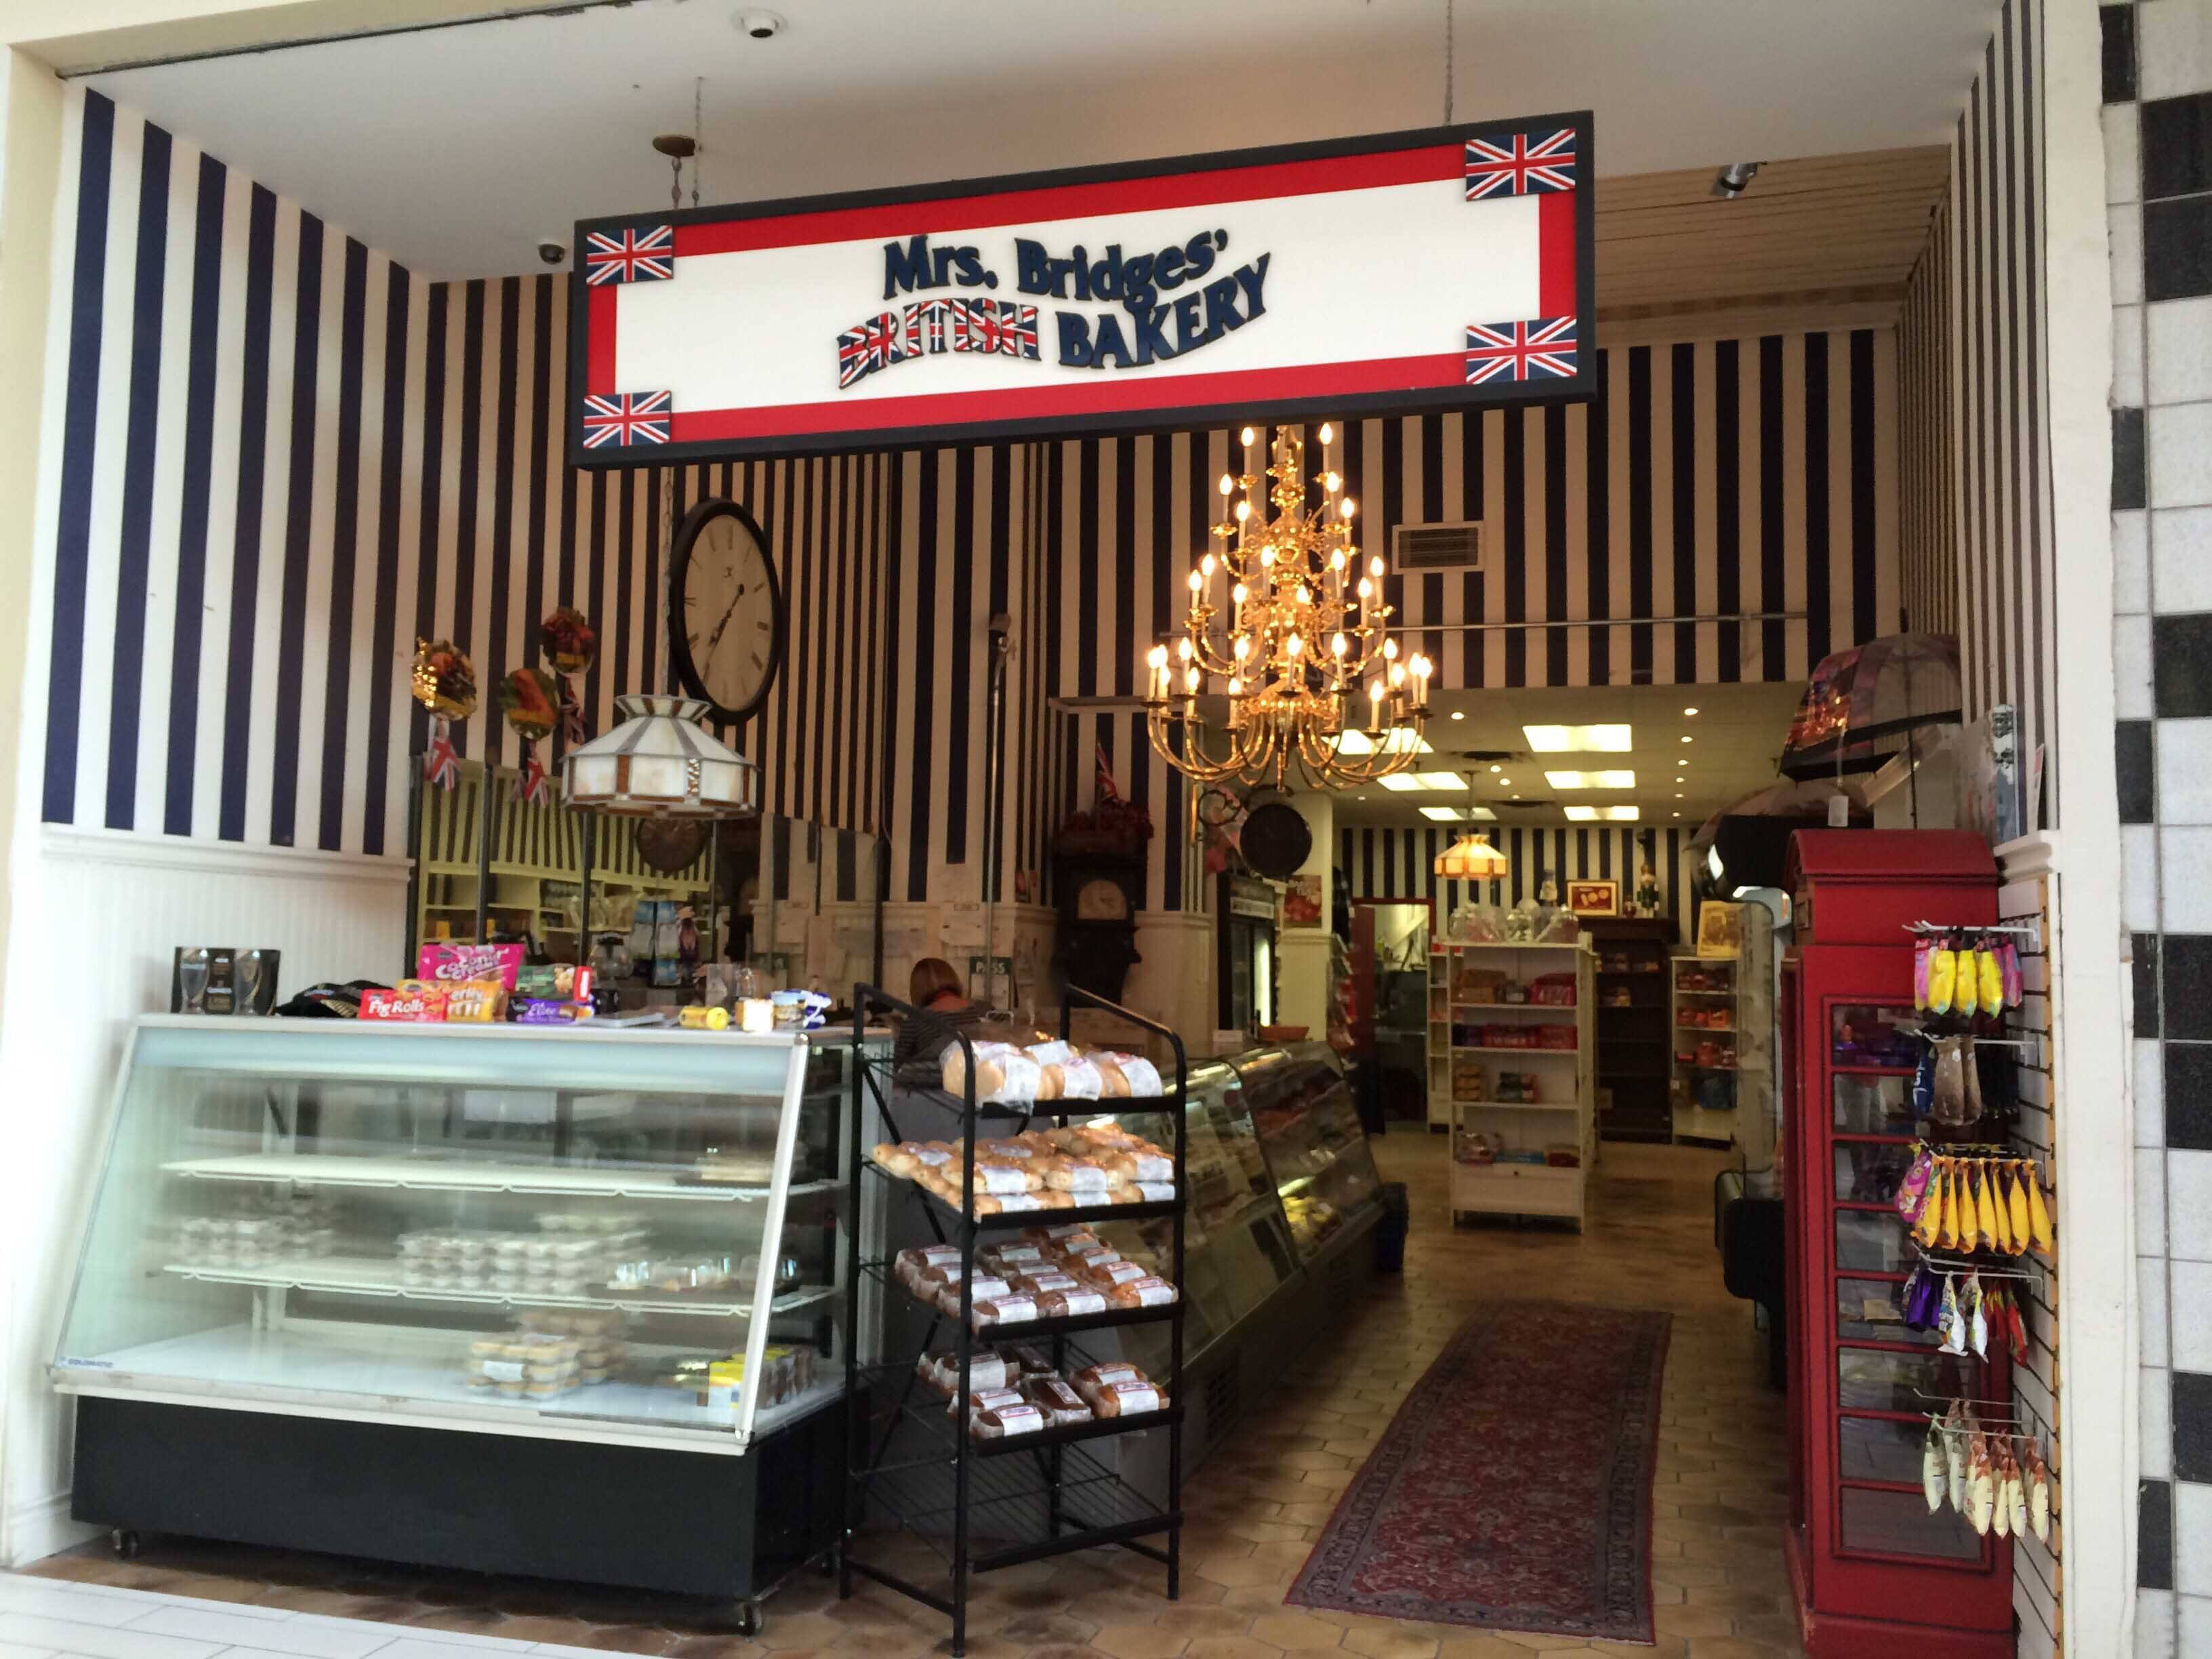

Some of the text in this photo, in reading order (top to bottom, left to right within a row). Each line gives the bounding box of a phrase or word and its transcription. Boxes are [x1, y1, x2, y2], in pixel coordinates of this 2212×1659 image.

[882, 228, 1228, 312] Mrs. Bridges'
[837, 251, 1271, 389] BRITISH BAKERY
[368, 998, 424, 1017] Fig Rolls
